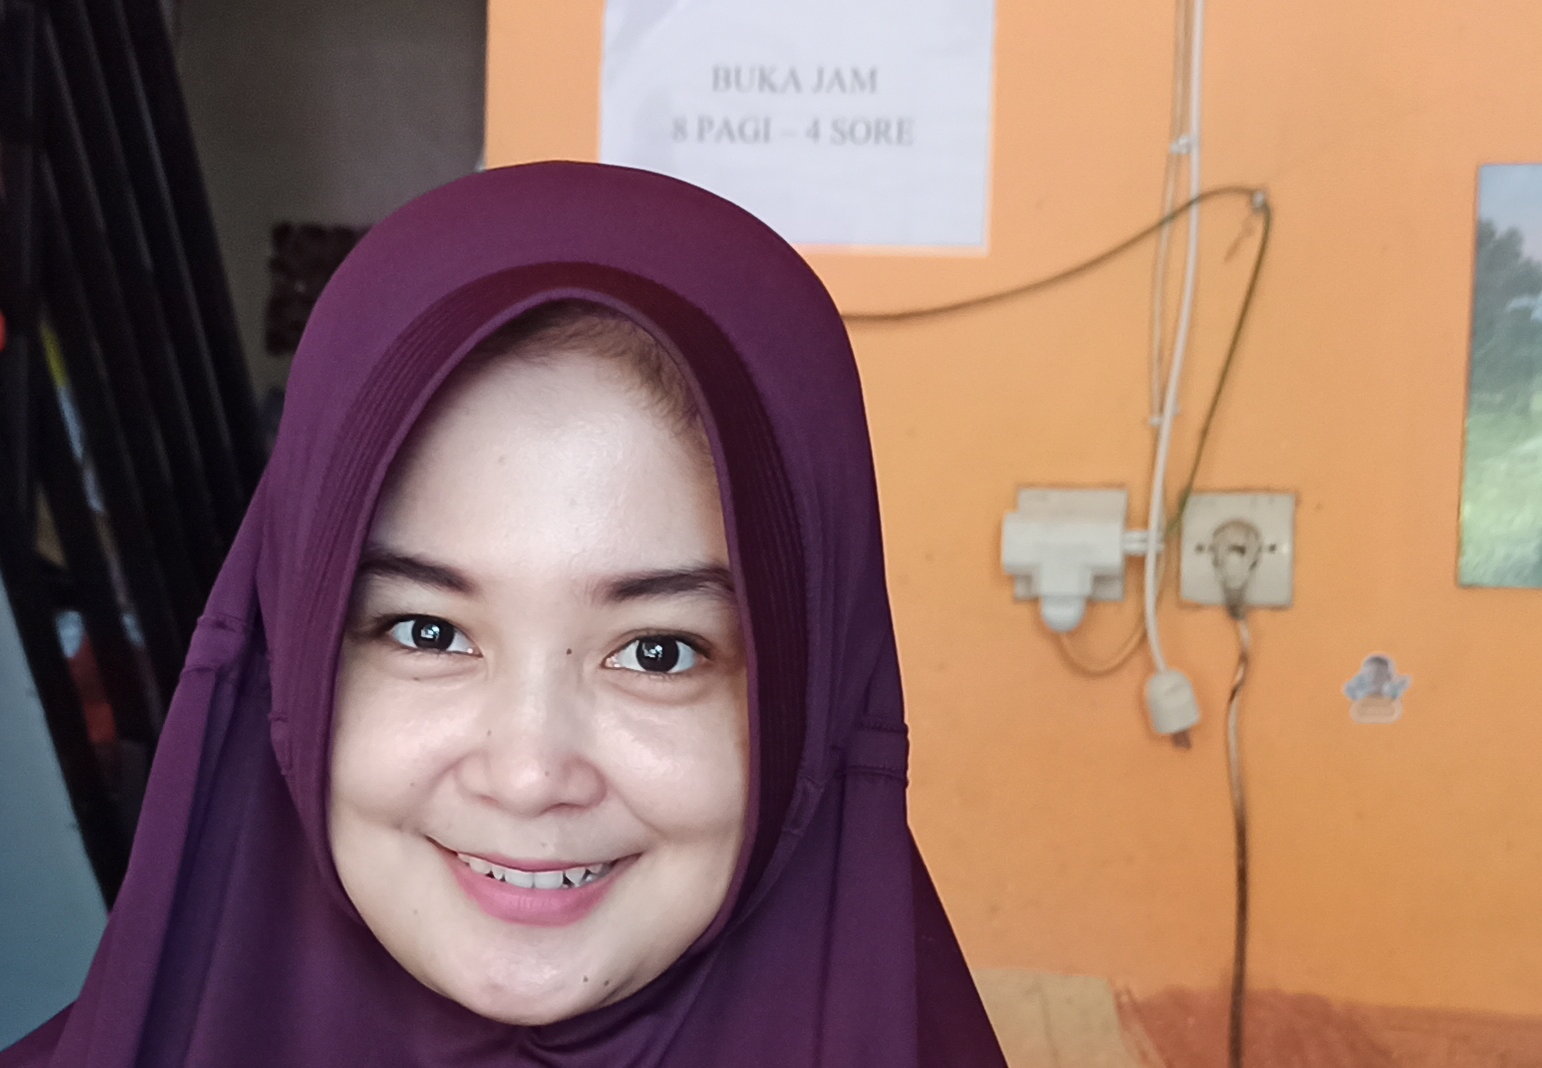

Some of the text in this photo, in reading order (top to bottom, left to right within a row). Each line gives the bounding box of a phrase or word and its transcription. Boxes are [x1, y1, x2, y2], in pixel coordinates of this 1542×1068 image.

[712, 66, 879, 95] BUKA JAM
[672, 117, 688, 143] 8
[696, 117, 772, 144] PAGI
[805, 117, 821, 143] 4
[830, 118, 915, 146] SORE
